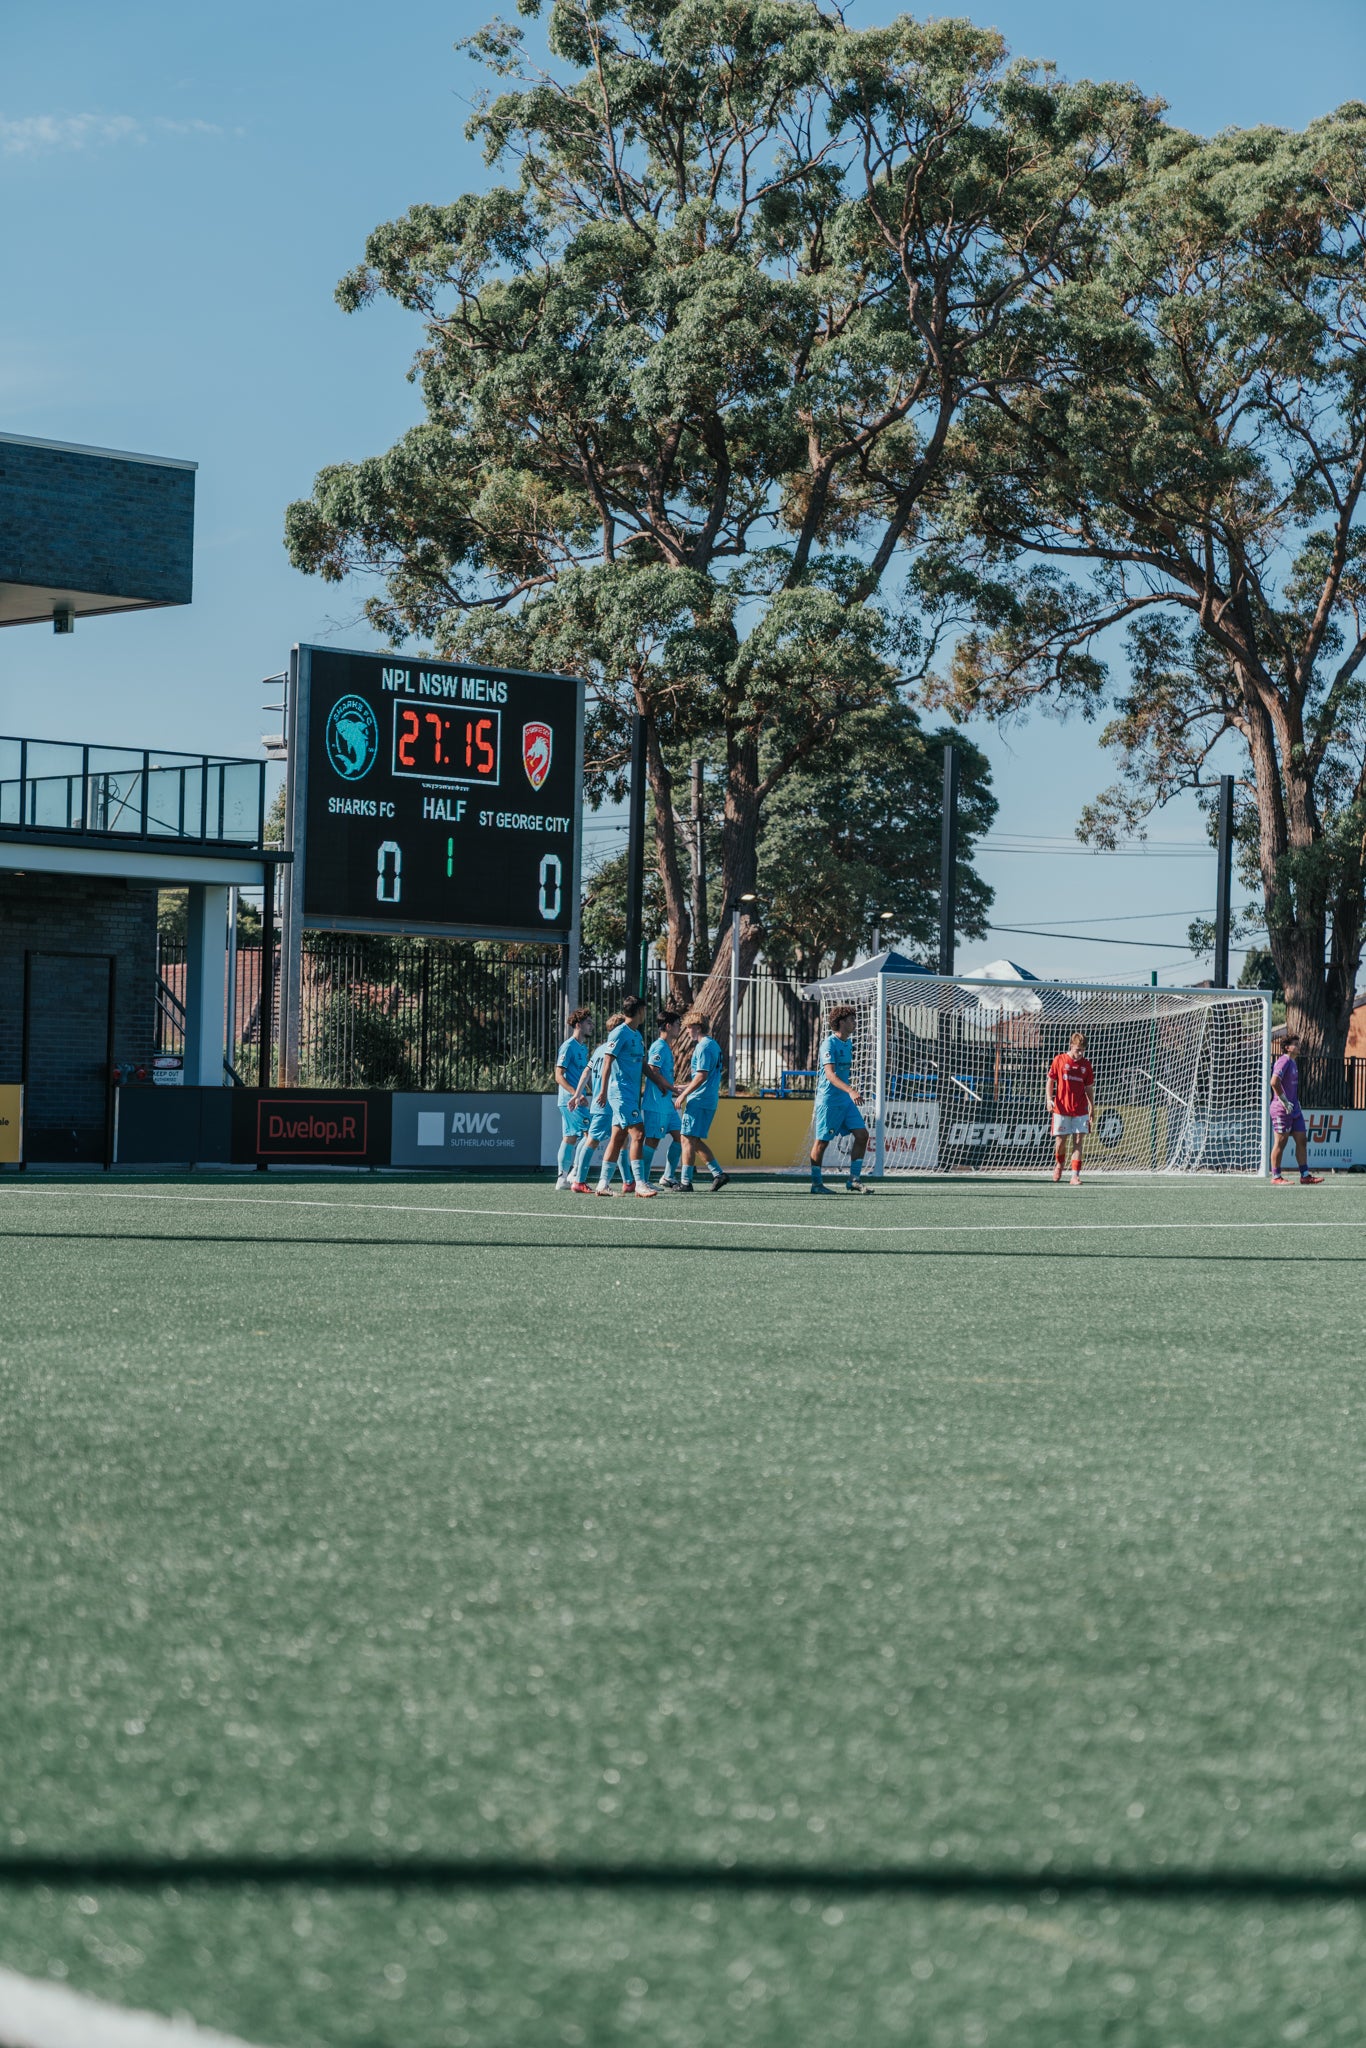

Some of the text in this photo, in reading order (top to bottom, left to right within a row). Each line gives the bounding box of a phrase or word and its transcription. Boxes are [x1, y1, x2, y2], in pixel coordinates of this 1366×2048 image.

[382, 667, 508, 704] NPL NSW MENS
[398, 710, 494, 773] 27:15
[328, 796, 396, 818] SHARKS FC
[422, 797, 467, 822] HALF
[478, 810, 570, 833] ST GEORGE CITY
[446, 837, 454, 878] 1
[376, 840, 403, 903] 0
[538, 853, 563, 920] 0
[269, 1115, 356, 1144] D.velop.R
[451, 1112, 501, 1134] RWC
[736, 1126, 761, 1142] PIPE
[948, 1122, 1051, 1146] DEPLOY
[450, 1138, 515, 1147] SUTHERLAND SHIRE
[736, 1142, 761, 1160] KING
[1313, 1148, 1327, 1158] JACK
[1329, 1149, 1353, 1158] HAULAGE
